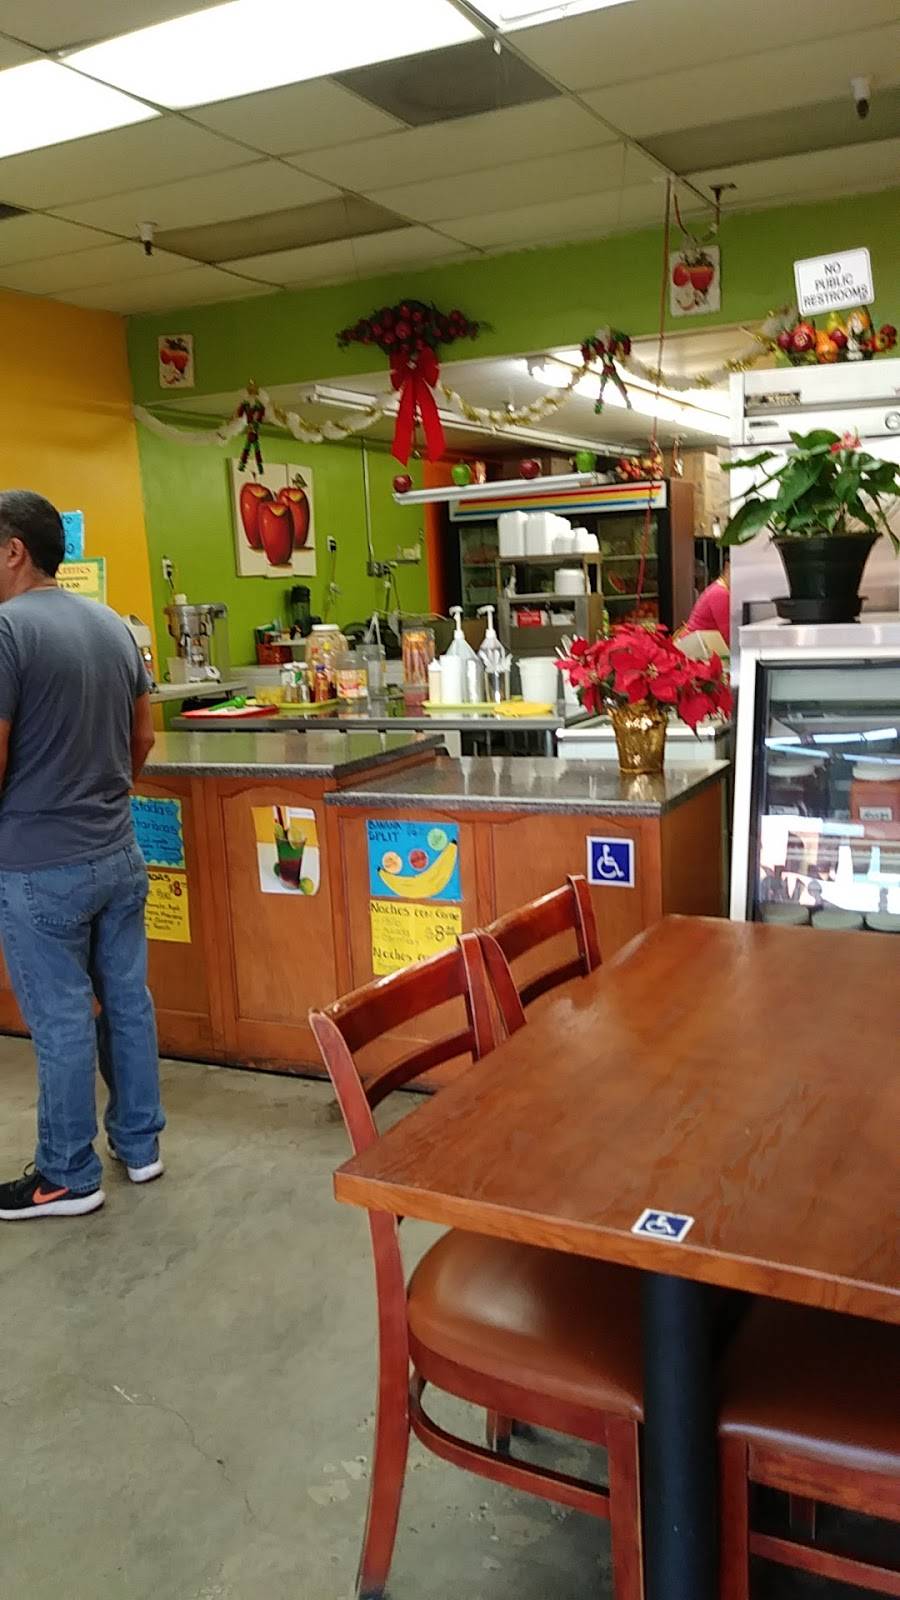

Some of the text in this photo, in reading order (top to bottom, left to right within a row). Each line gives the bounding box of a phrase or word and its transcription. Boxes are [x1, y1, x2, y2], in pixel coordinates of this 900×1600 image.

[824, 260, 841, 275] NO
[815, 272, 854, 291] PUBLIC
[803, 284, 869, 307] RESTROOMS
